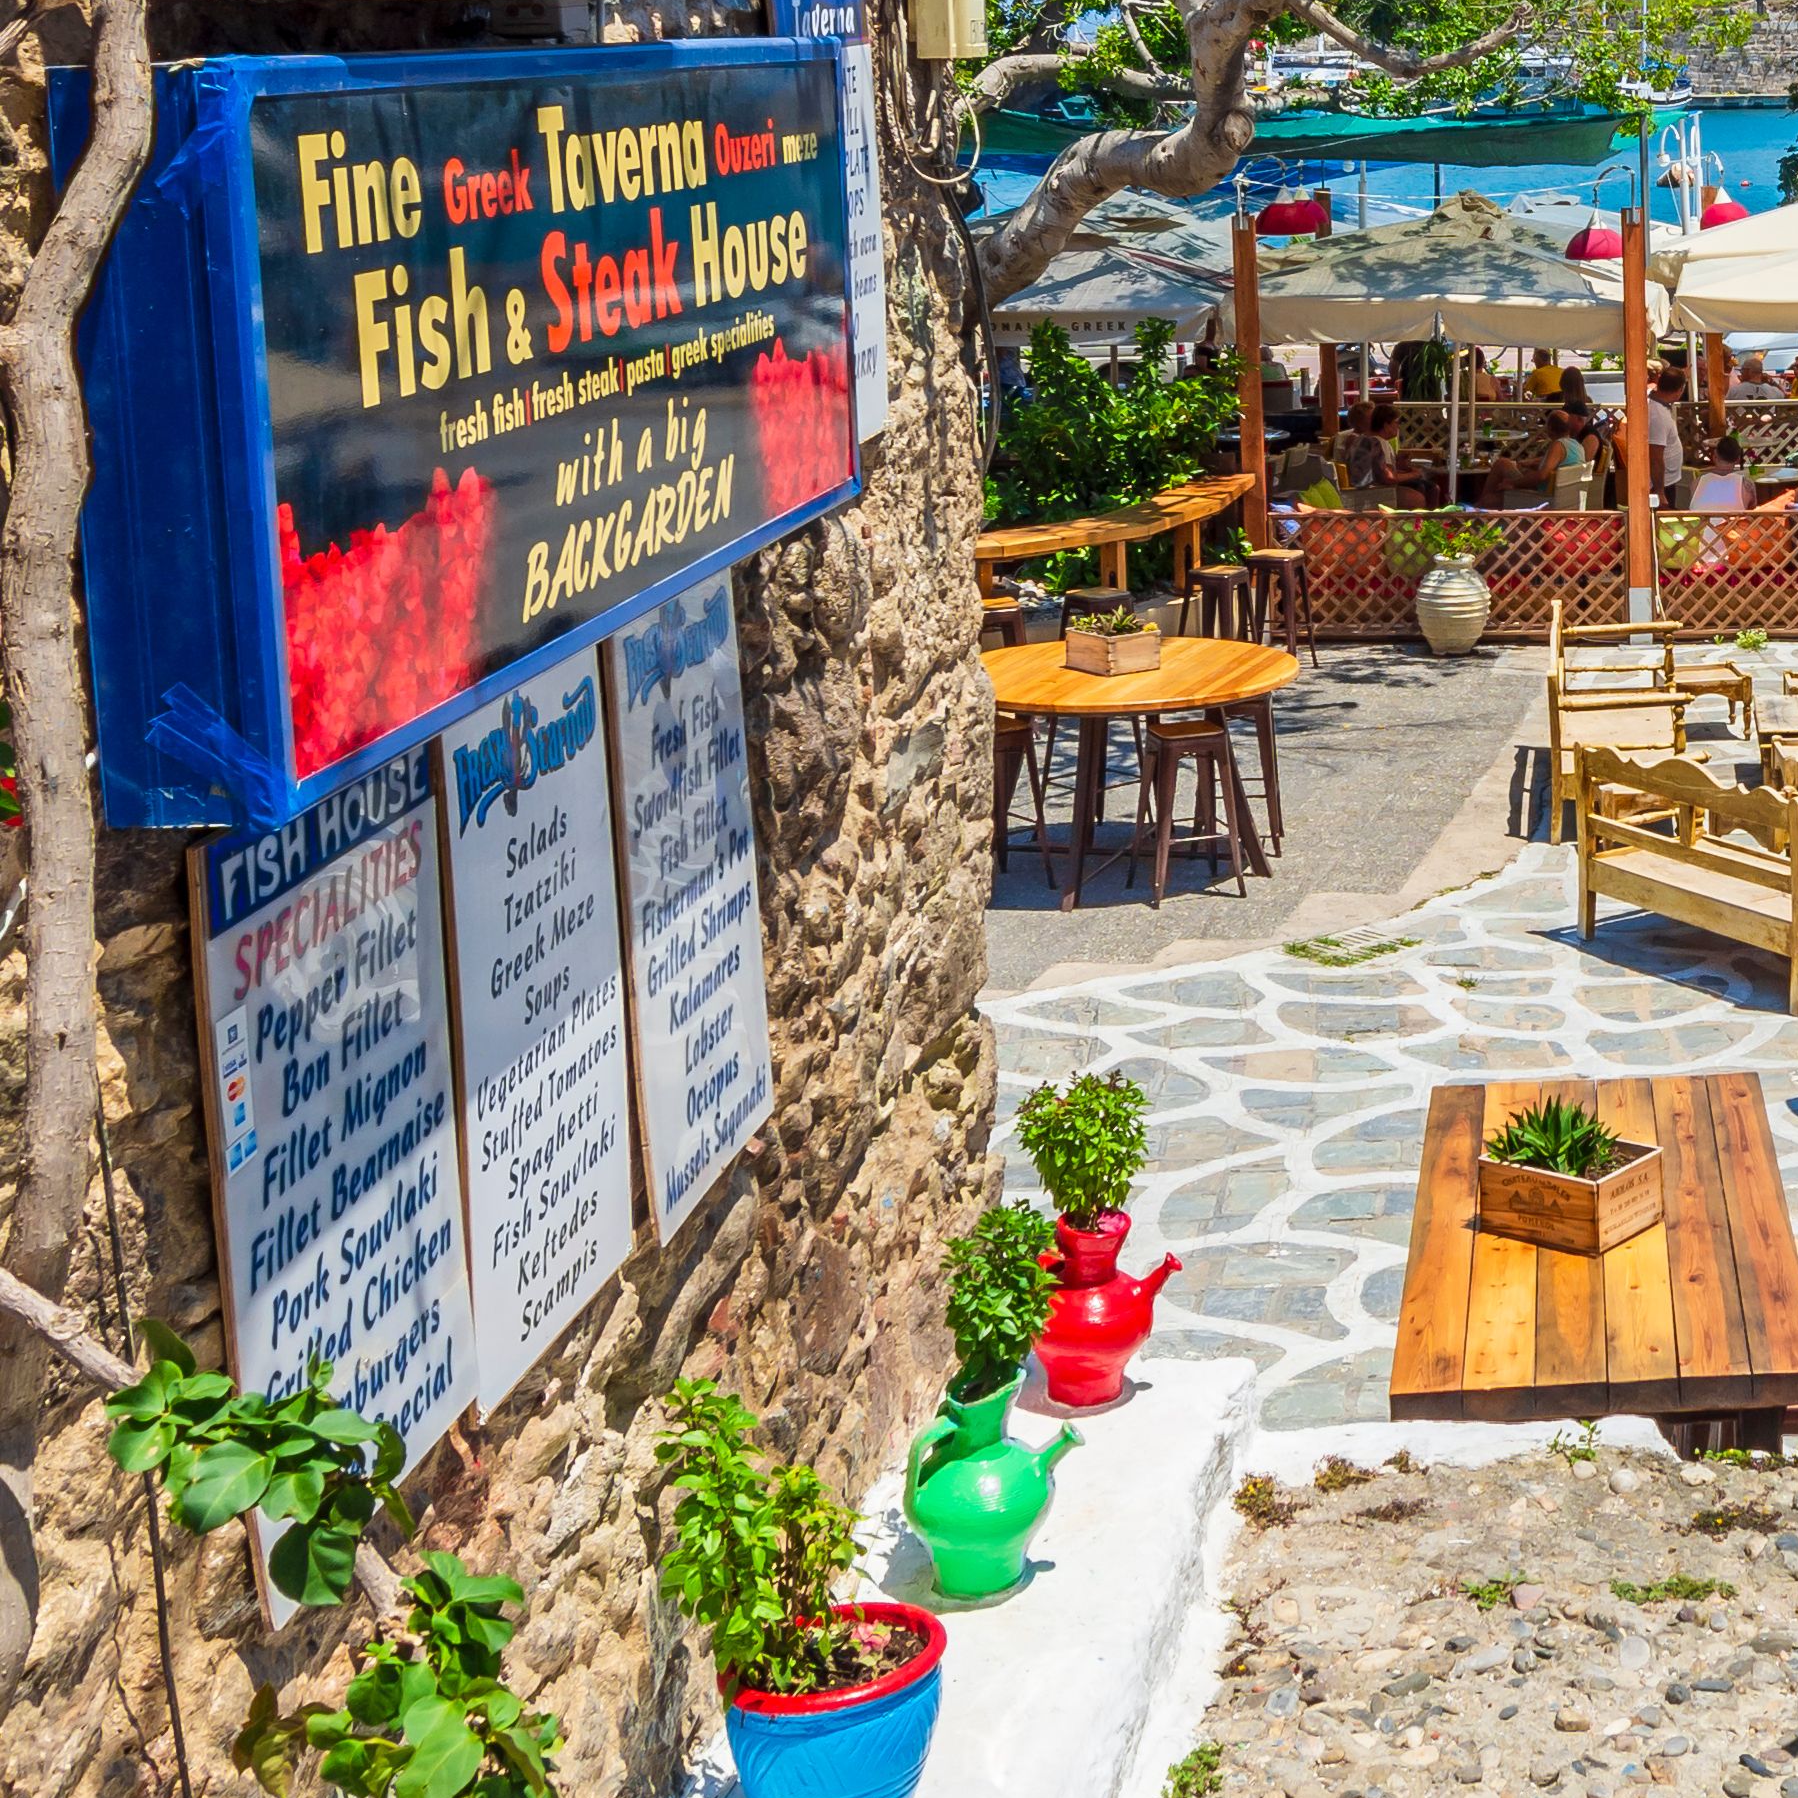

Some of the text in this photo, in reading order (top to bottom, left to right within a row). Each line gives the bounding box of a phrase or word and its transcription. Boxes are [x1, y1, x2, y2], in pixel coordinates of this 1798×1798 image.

[298, 105, 818, 254] Fine Greek Taverna Ouzeri meze
[354, 201, 807, 408] Fish & Steak House
[854, 270, 877, 300] beans
[1072, 321, 1127, 332] GREEK
[440, 310, 775, 453] fresh fish fresh steak pasta greek specialities
[556, 397, 707, 506] with a big
[522, 454, 734, 623] BACKGARDEN
[634, 728, 741, 839] Swordfish Fillet
[651, 682, 719, 770] Fresh Fish
[221, 753, 427, 920] FISH HOUSE
[504, 847, 576, 934] Tzatziki
[506, 805, 567, 879] Salads
[642, 826, 749, 948] Fisherman's Pot
[660, 797, 728, 880] Fish Fillet
[234, 819, 423, 1001] SPECIALITIES
[491, 892, 594, 999] Greek Meze
[647, 881, 751, 998] Grilled Shrimps
[256, 909, 417, 1064] Pepper Fillet
[524, 965, 569, 1026] Soups
[669, 942, 741, 1035] Kalamares
[685, 1003, 734, 1075] Lobster
[282, 988, 403, 1118] Bon Fillet
[476, 972, 617, 1122] Vegetarian Plates
[482, 1023, 618, 1172] Stuffed Tomatoes
[686, 1050, 739, 1129] Octopus
[263, 1041, 427, 1211] Fillet Mignon
[508, 1082, 599, 1200] Spaghetti
[666, 1063, 767, 1215] Mussels Saganaki
[250, 1091, 445, 1296] Fillet Bearnaise
[492, 1113, 616, 1270] Fish Souvlaki
[517, 1190, 599, 1294] Keftedes
[272, 1150, 438, 1350] Pork Souvlaki
[362, 1218, 452, 1331] Chicken
[521, 1238, 598, 1342] Scampis
[341, 1299, 440, 1414] burgers
[374, 1334, 454, 1438] ecial
